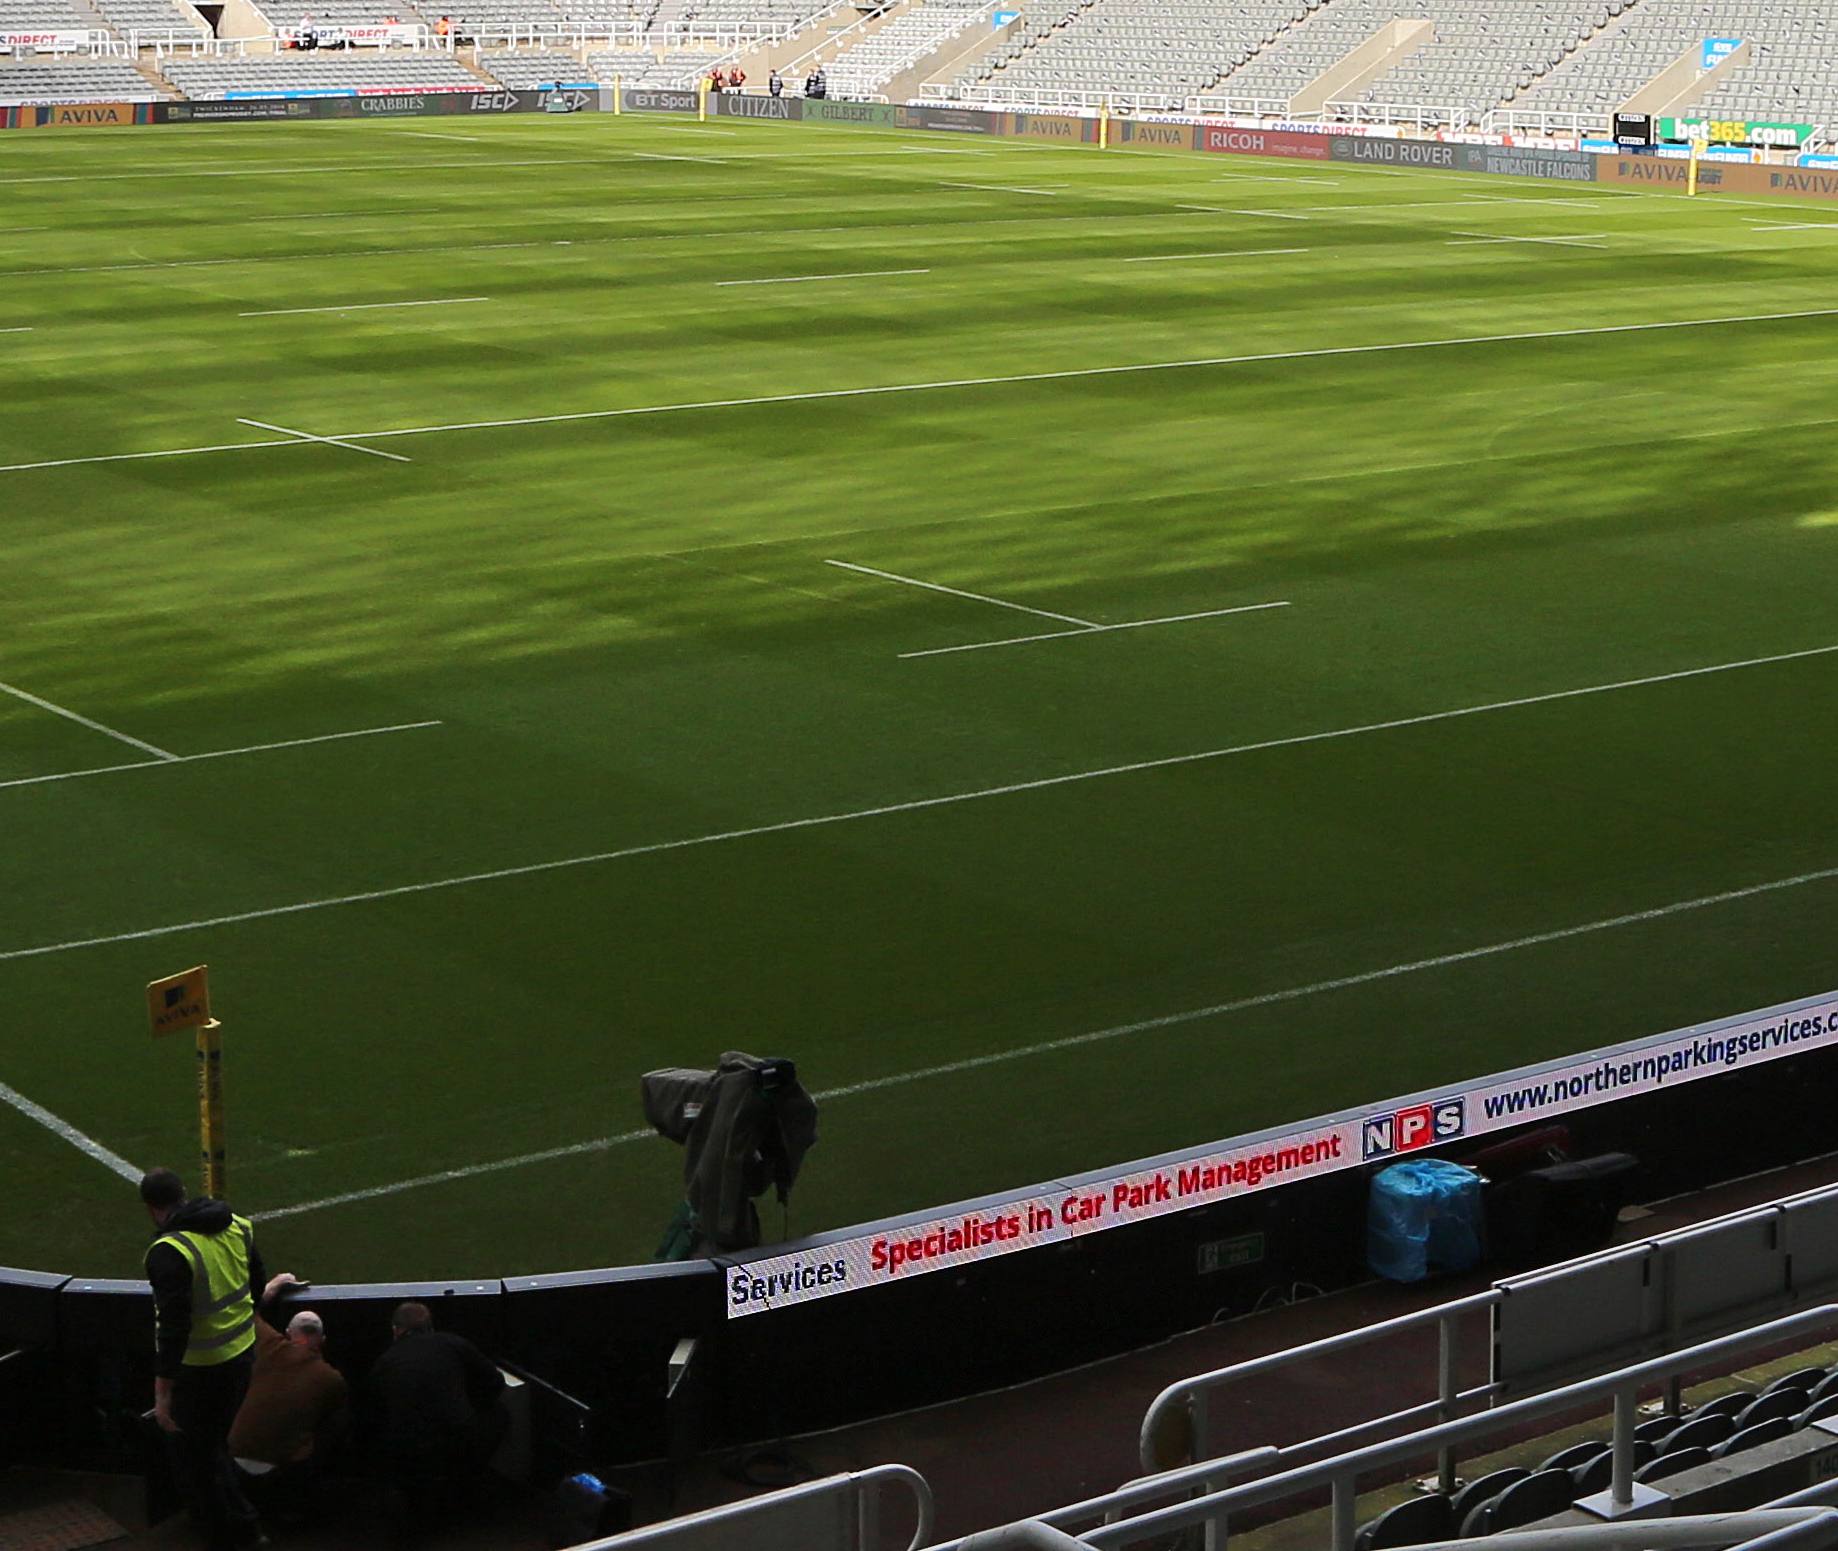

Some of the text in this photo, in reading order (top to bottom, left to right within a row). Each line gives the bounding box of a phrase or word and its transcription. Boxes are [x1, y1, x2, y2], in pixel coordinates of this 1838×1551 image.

[361, 96, 425, 112] CRABBIE'S
[471, 94, 506, 110] ISC
[635, 93, 695, 109] BT Sport
[728, 96, 789, 119] CITIZEN
[59, 108, 119, 124] AVIVA
[821, 102, 875, 122] GILBERT
[1031, 120, 1071, 136] AVIVA
[1138, 127, 1182, 144] AVIVA
[1674, 119, 1798, 146] bet365.com
[1210, 132, 1265, 151] RICOH
[1354, 141, 1453, 165] LAND ROVER
[1487, 156, 1591, 179] NEWCASTLE FALCONS
[1631, 163, 1688, 182] AVIVA
[731, 1258, 848, 1306] Services
[871, 1216, 1020, 1275] Specialists
[1028, 1206, 1054, 1234] in
[1062, 1188, 1104, 1225] Car
[1113, 1169, 1171, 1212] Park
[1178, 1133, 1342, 1198] Management
[1365, 1100, 1464, 1159] NPS
